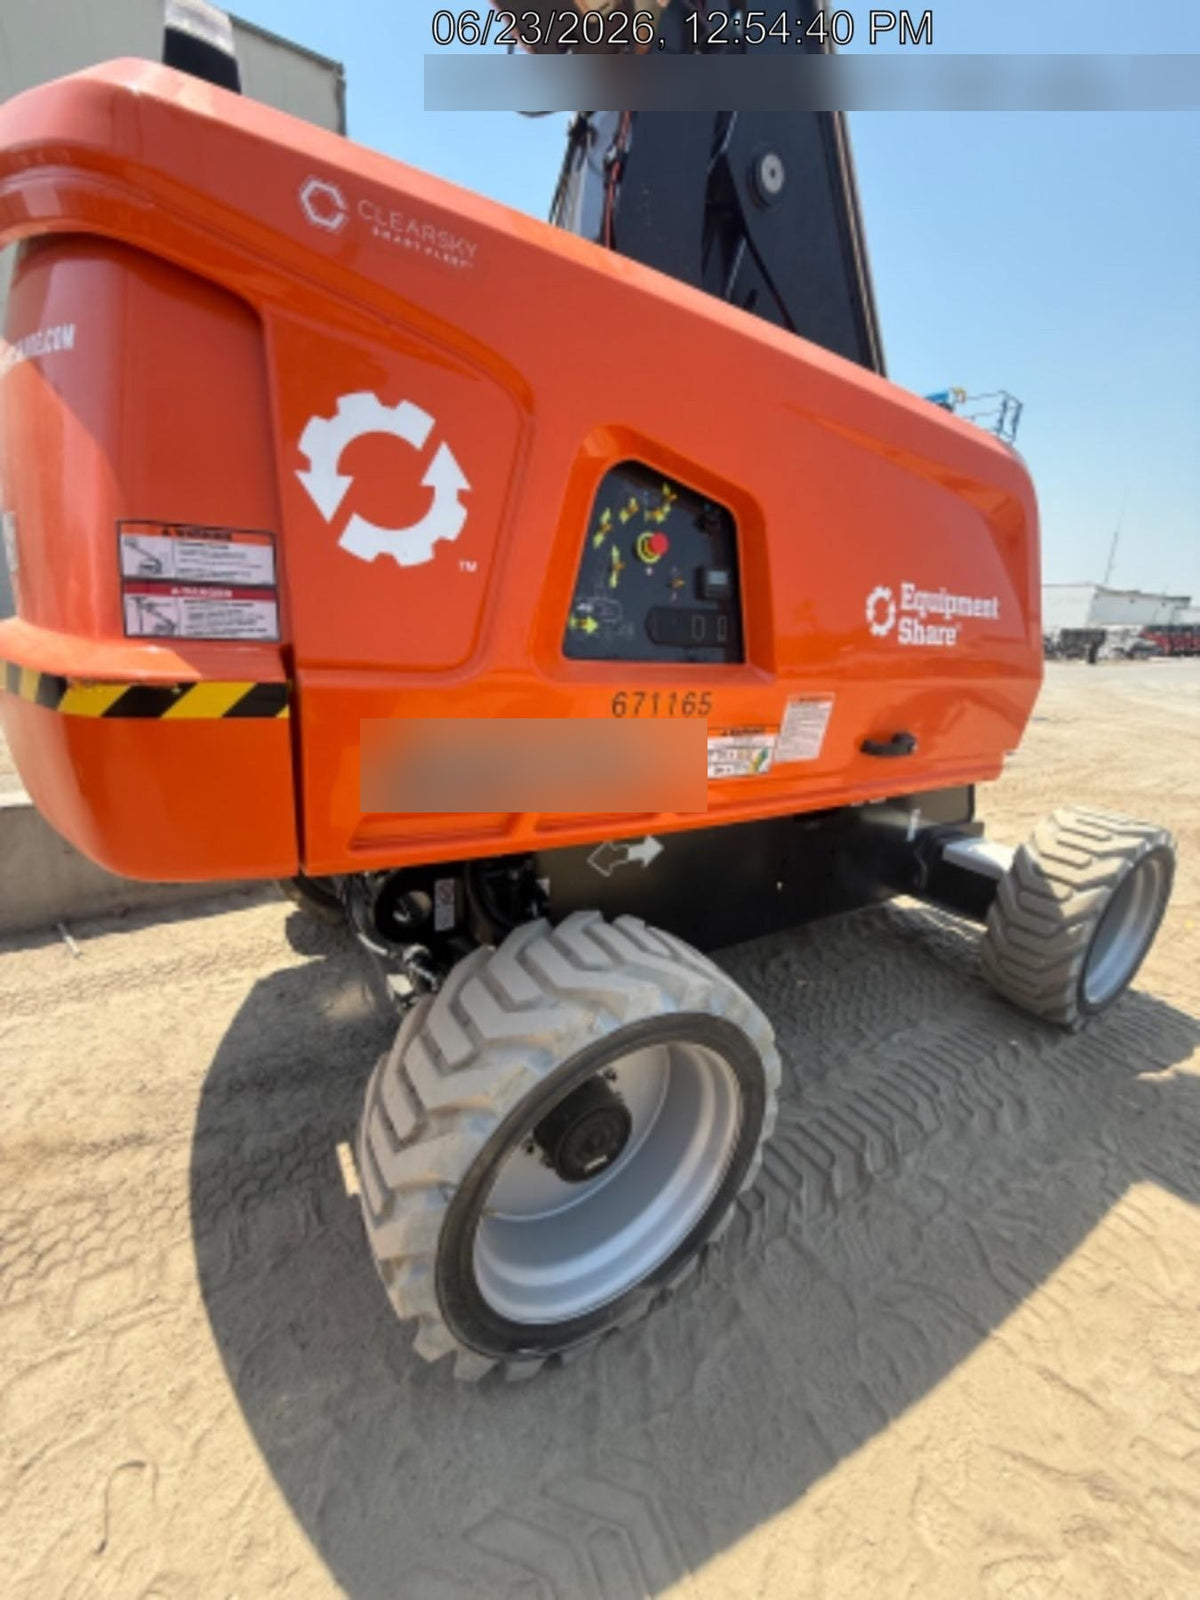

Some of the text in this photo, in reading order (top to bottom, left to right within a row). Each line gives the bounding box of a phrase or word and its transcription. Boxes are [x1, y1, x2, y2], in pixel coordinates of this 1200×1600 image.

[357, 199, 478, 258] CLEARSKY
[901, 582, 999, 620] Equipment
[611, 690, 712, 718] 671165
